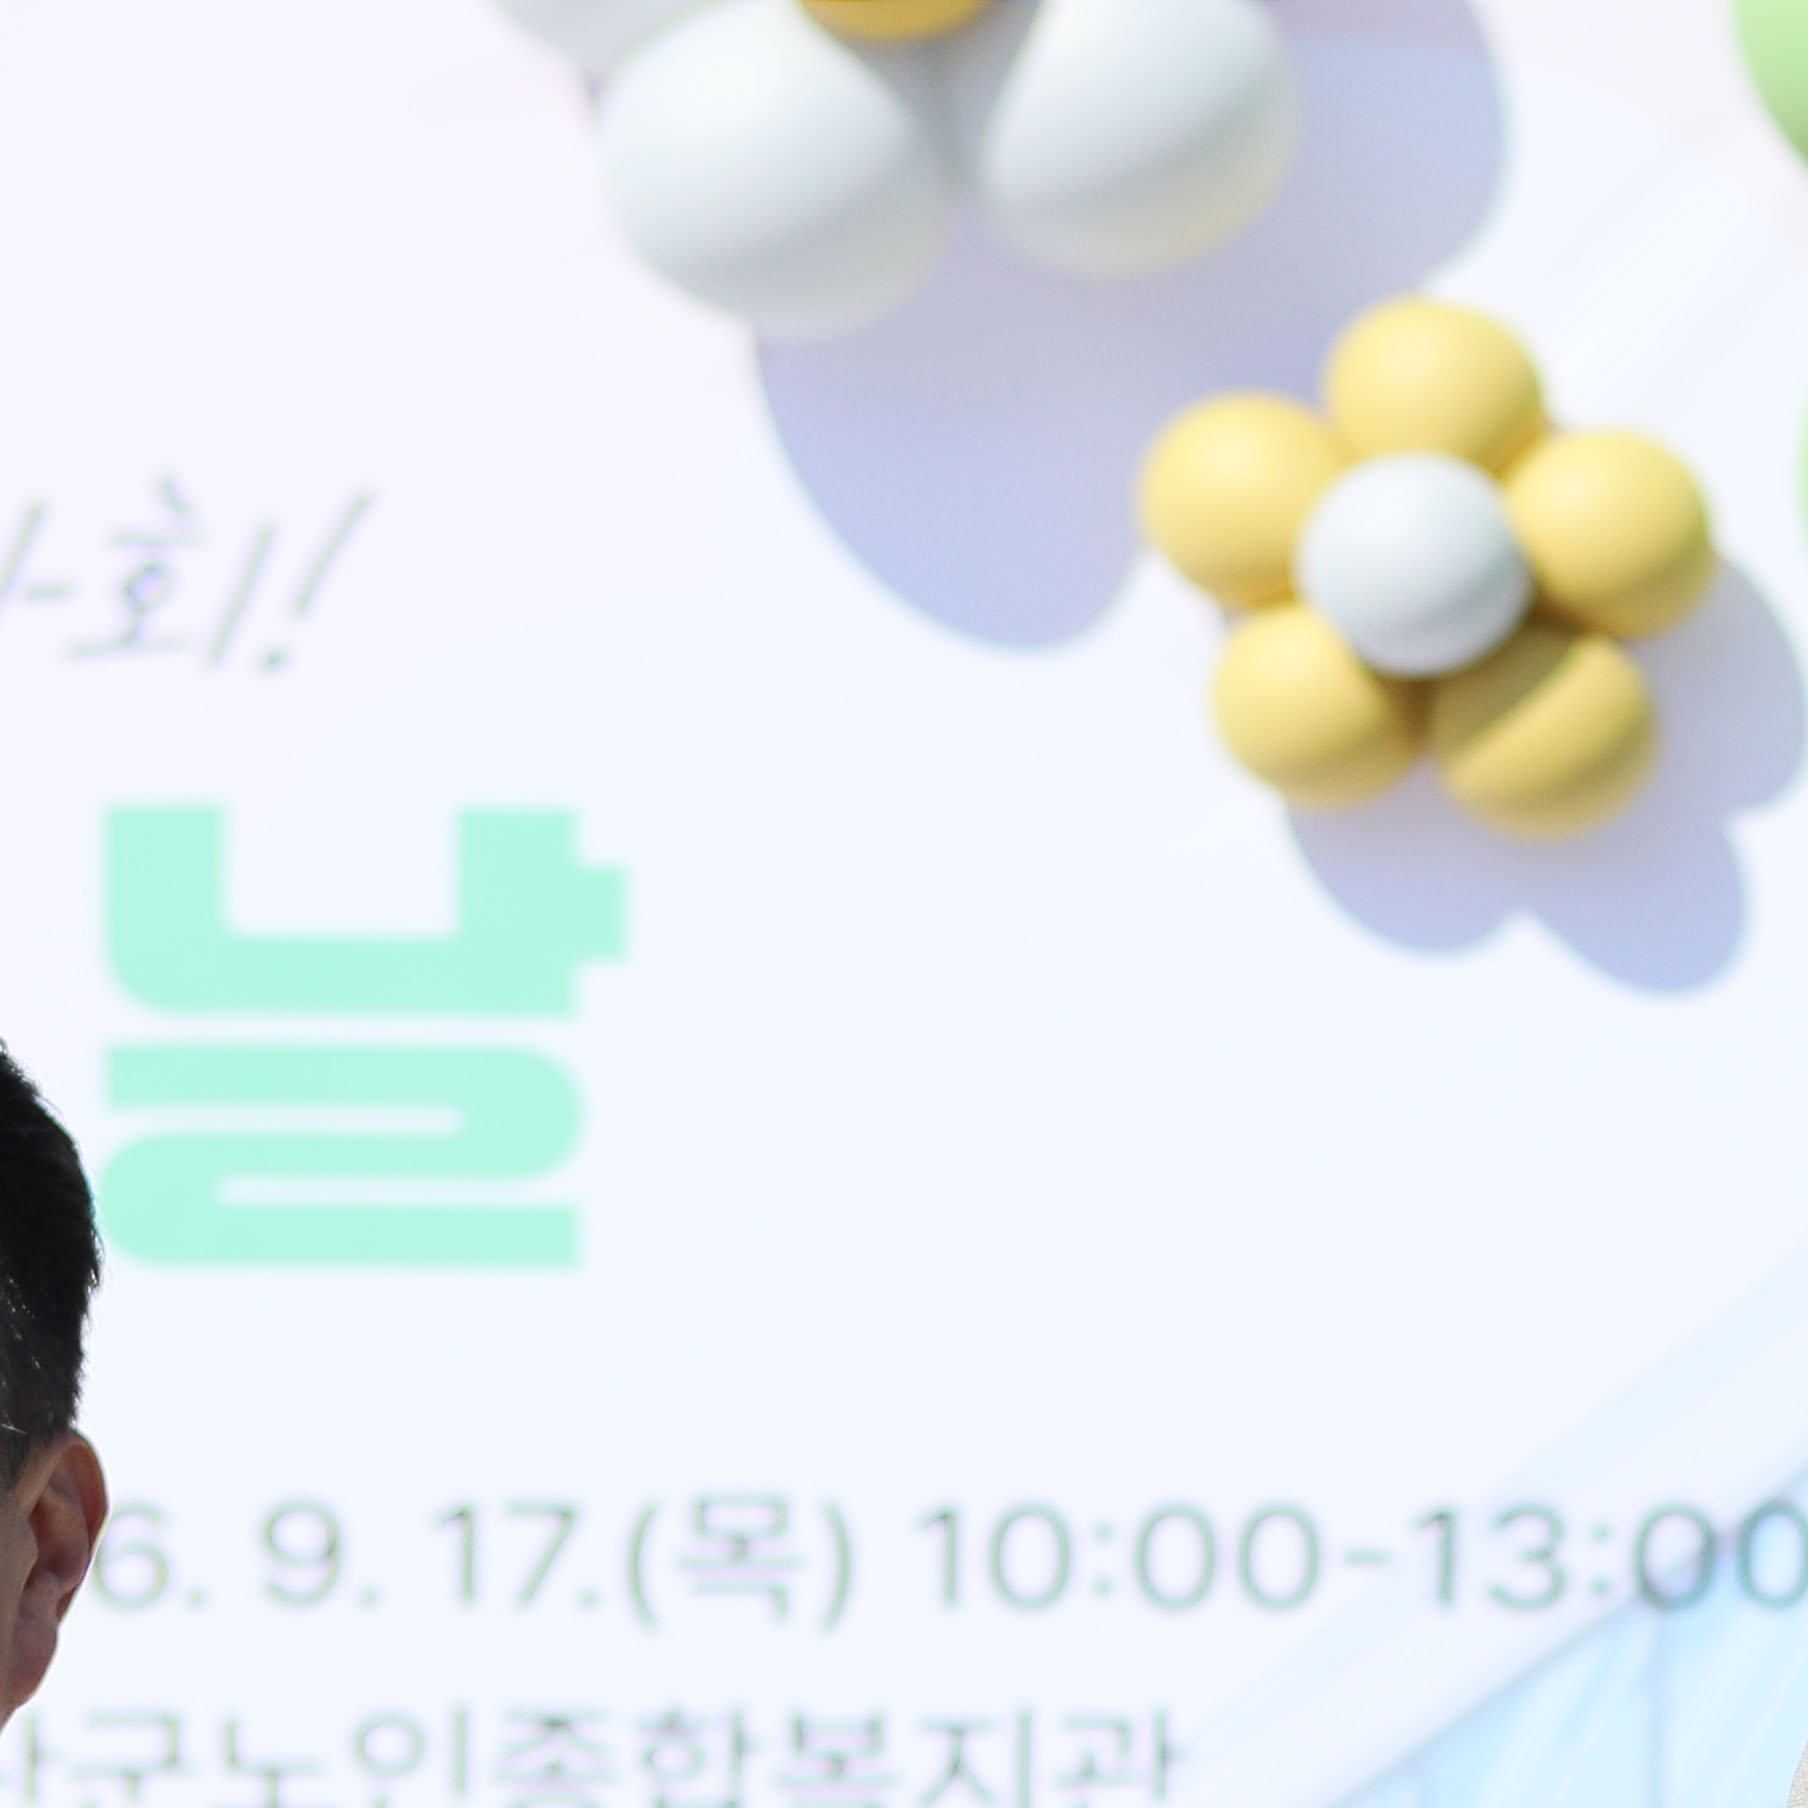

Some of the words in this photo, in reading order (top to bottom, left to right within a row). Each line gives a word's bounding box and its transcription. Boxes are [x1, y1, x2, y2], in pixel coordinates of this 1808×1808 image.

[99, 802, 630, 1272] 날
[260, 1500, 378, 1608] 9.
[436, 1494, 852, 1630] 17.(목)
